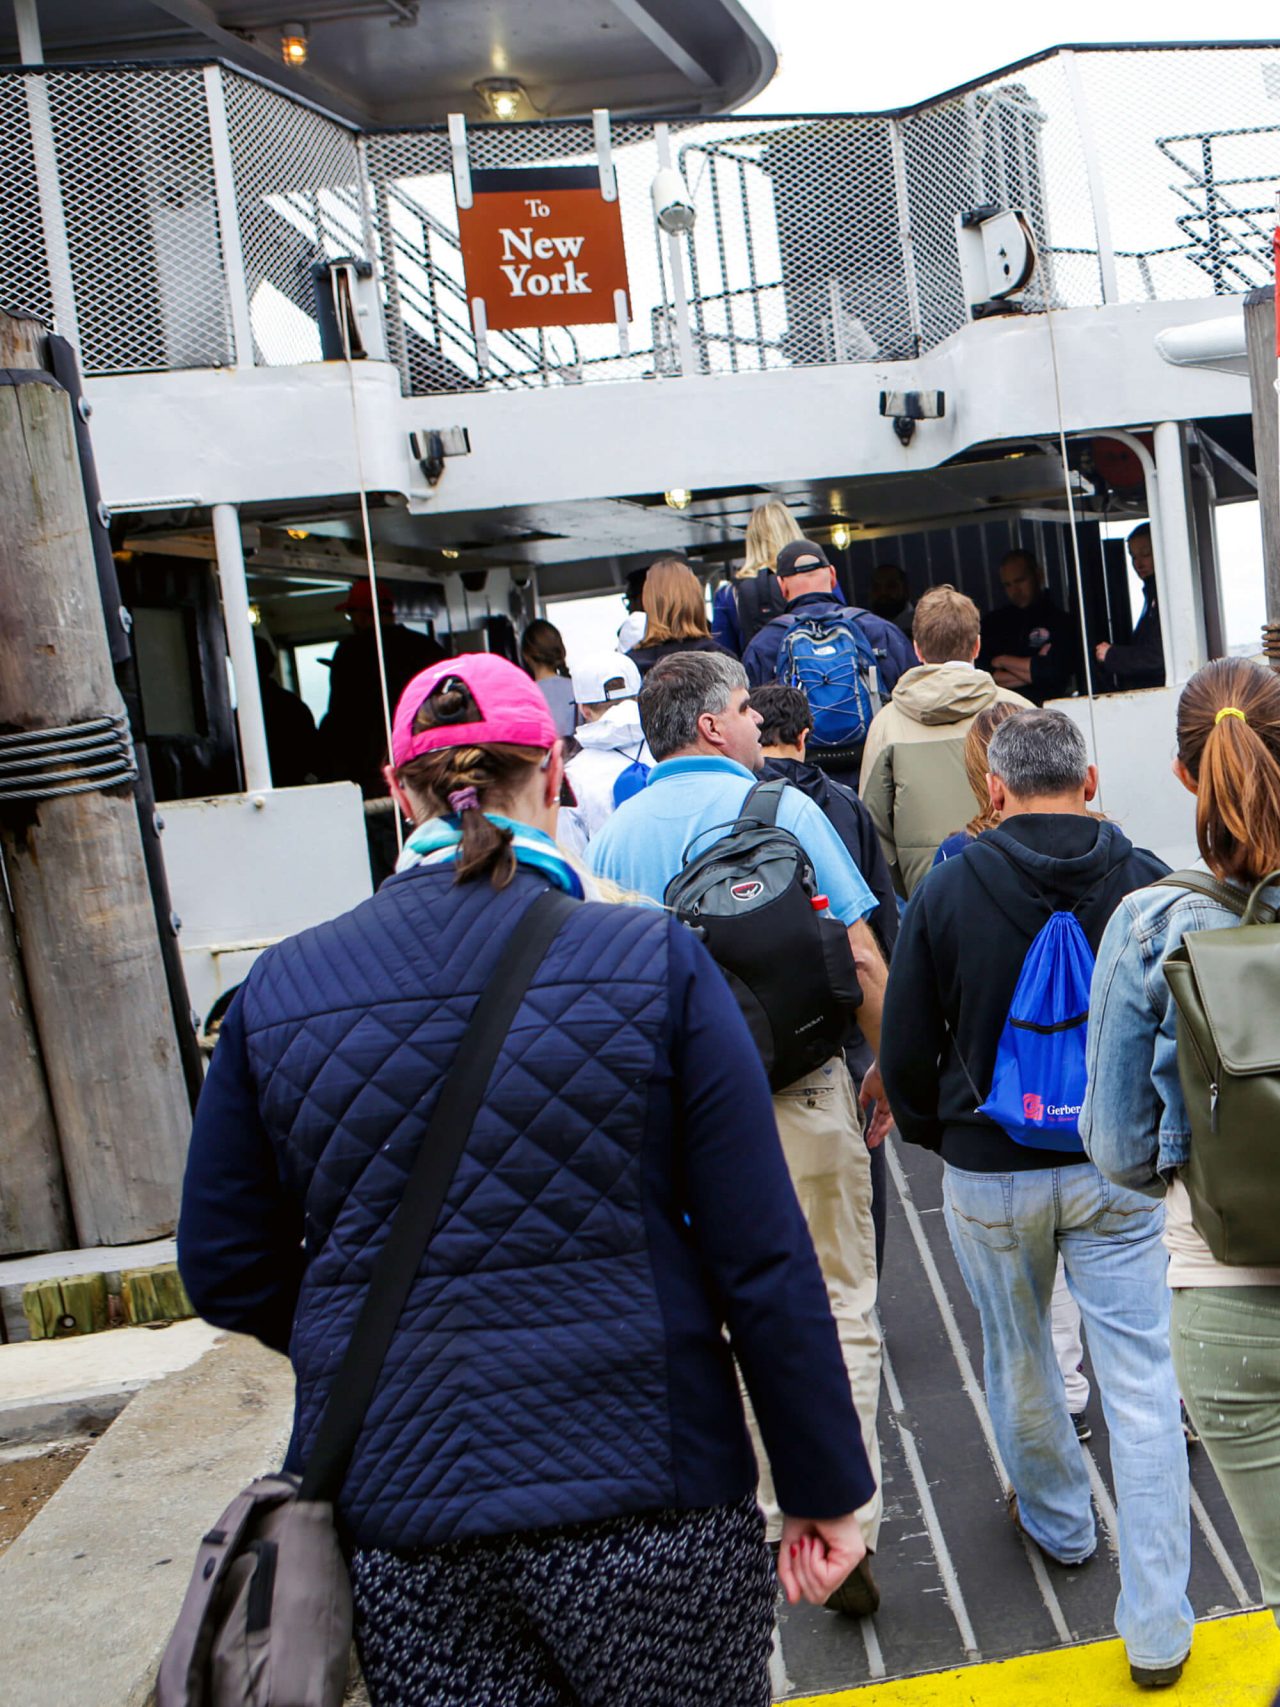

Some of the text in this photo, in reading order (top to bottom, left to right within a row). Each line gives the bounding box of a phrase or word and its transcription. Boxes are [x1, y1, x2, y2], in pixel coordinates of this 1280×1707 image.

[525, 199, 550, 217] To
[498, 228, 585, 260] New
[499, 260, 592, 297] York
[1047, 1104, 1081, 1116] Gerber
